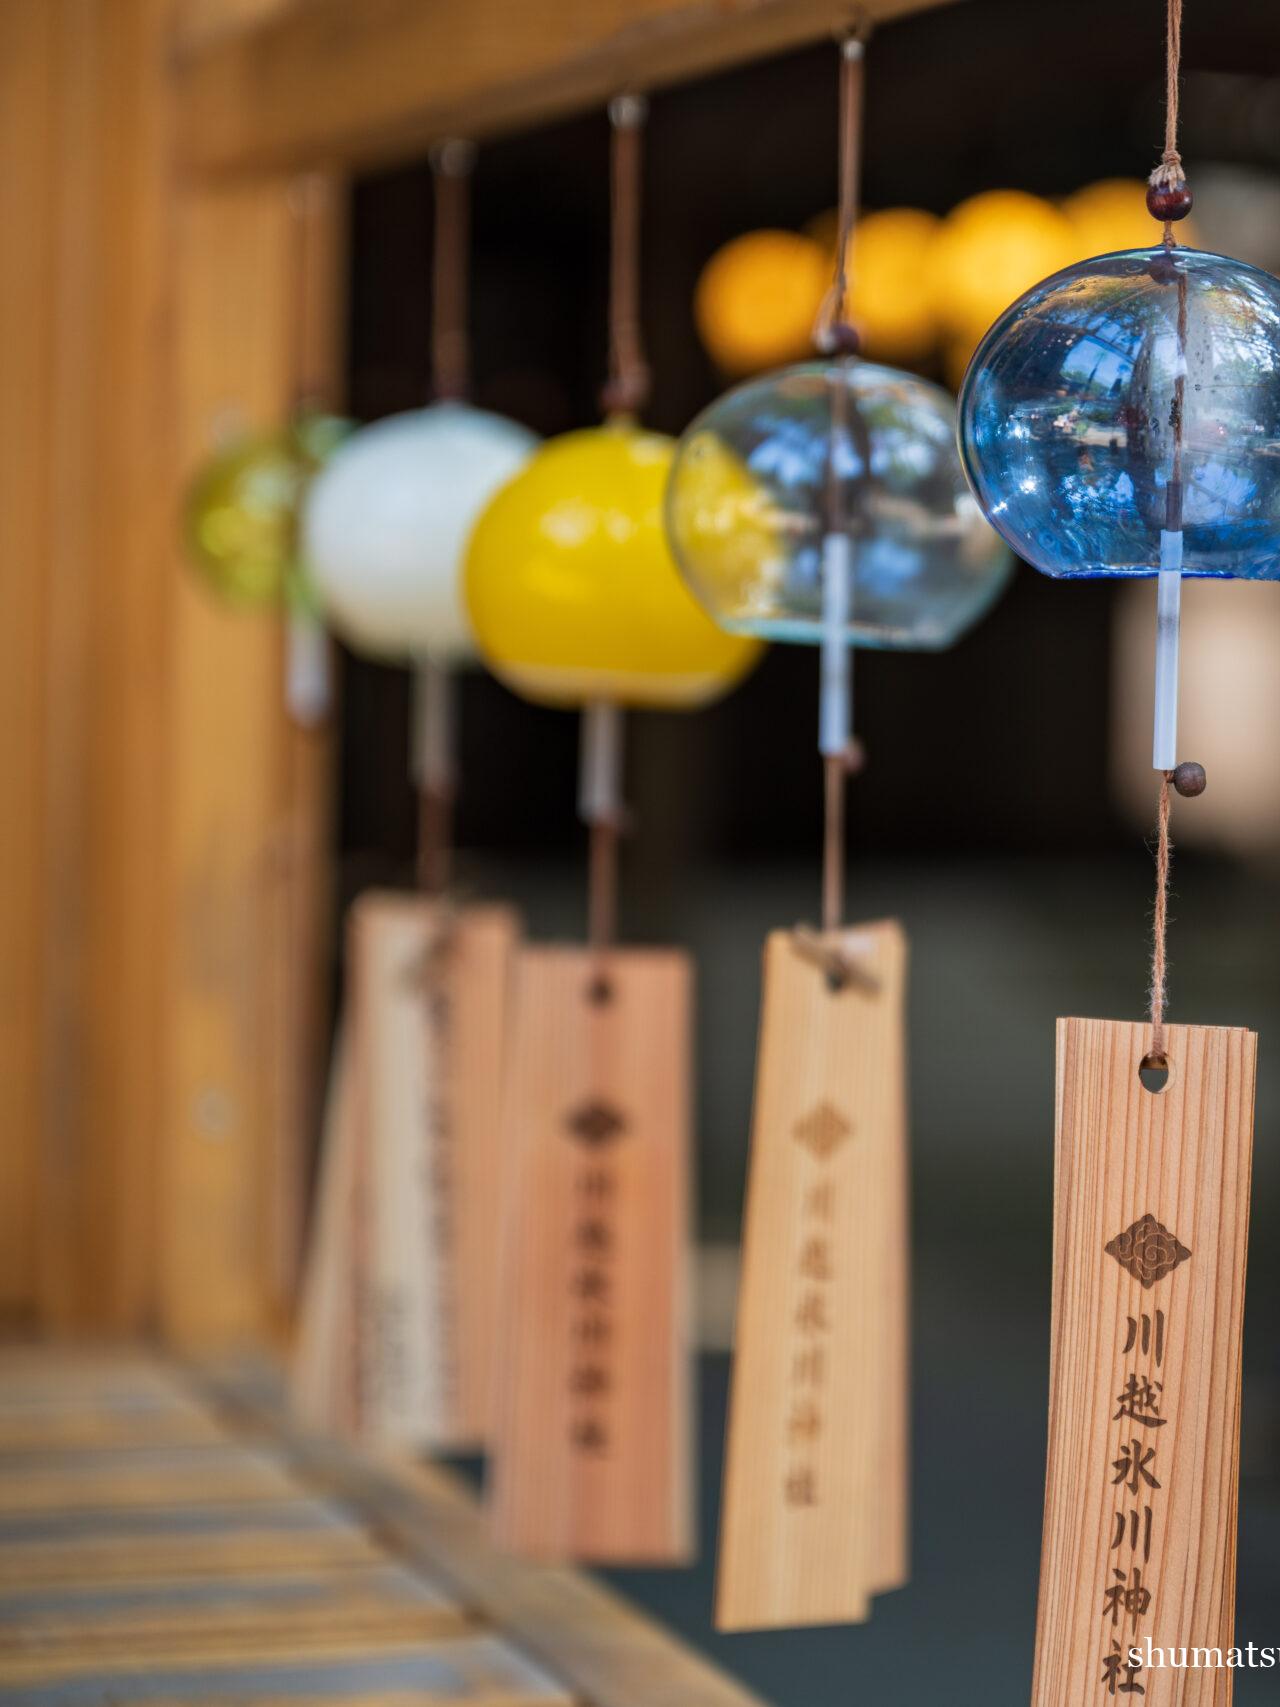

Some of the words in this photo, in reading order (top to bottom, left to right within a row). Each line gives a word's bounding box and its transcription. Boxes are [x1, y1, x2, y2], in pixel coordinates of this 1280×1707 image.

[1100, 1309, 1167, 1697] 川越氷川神社
